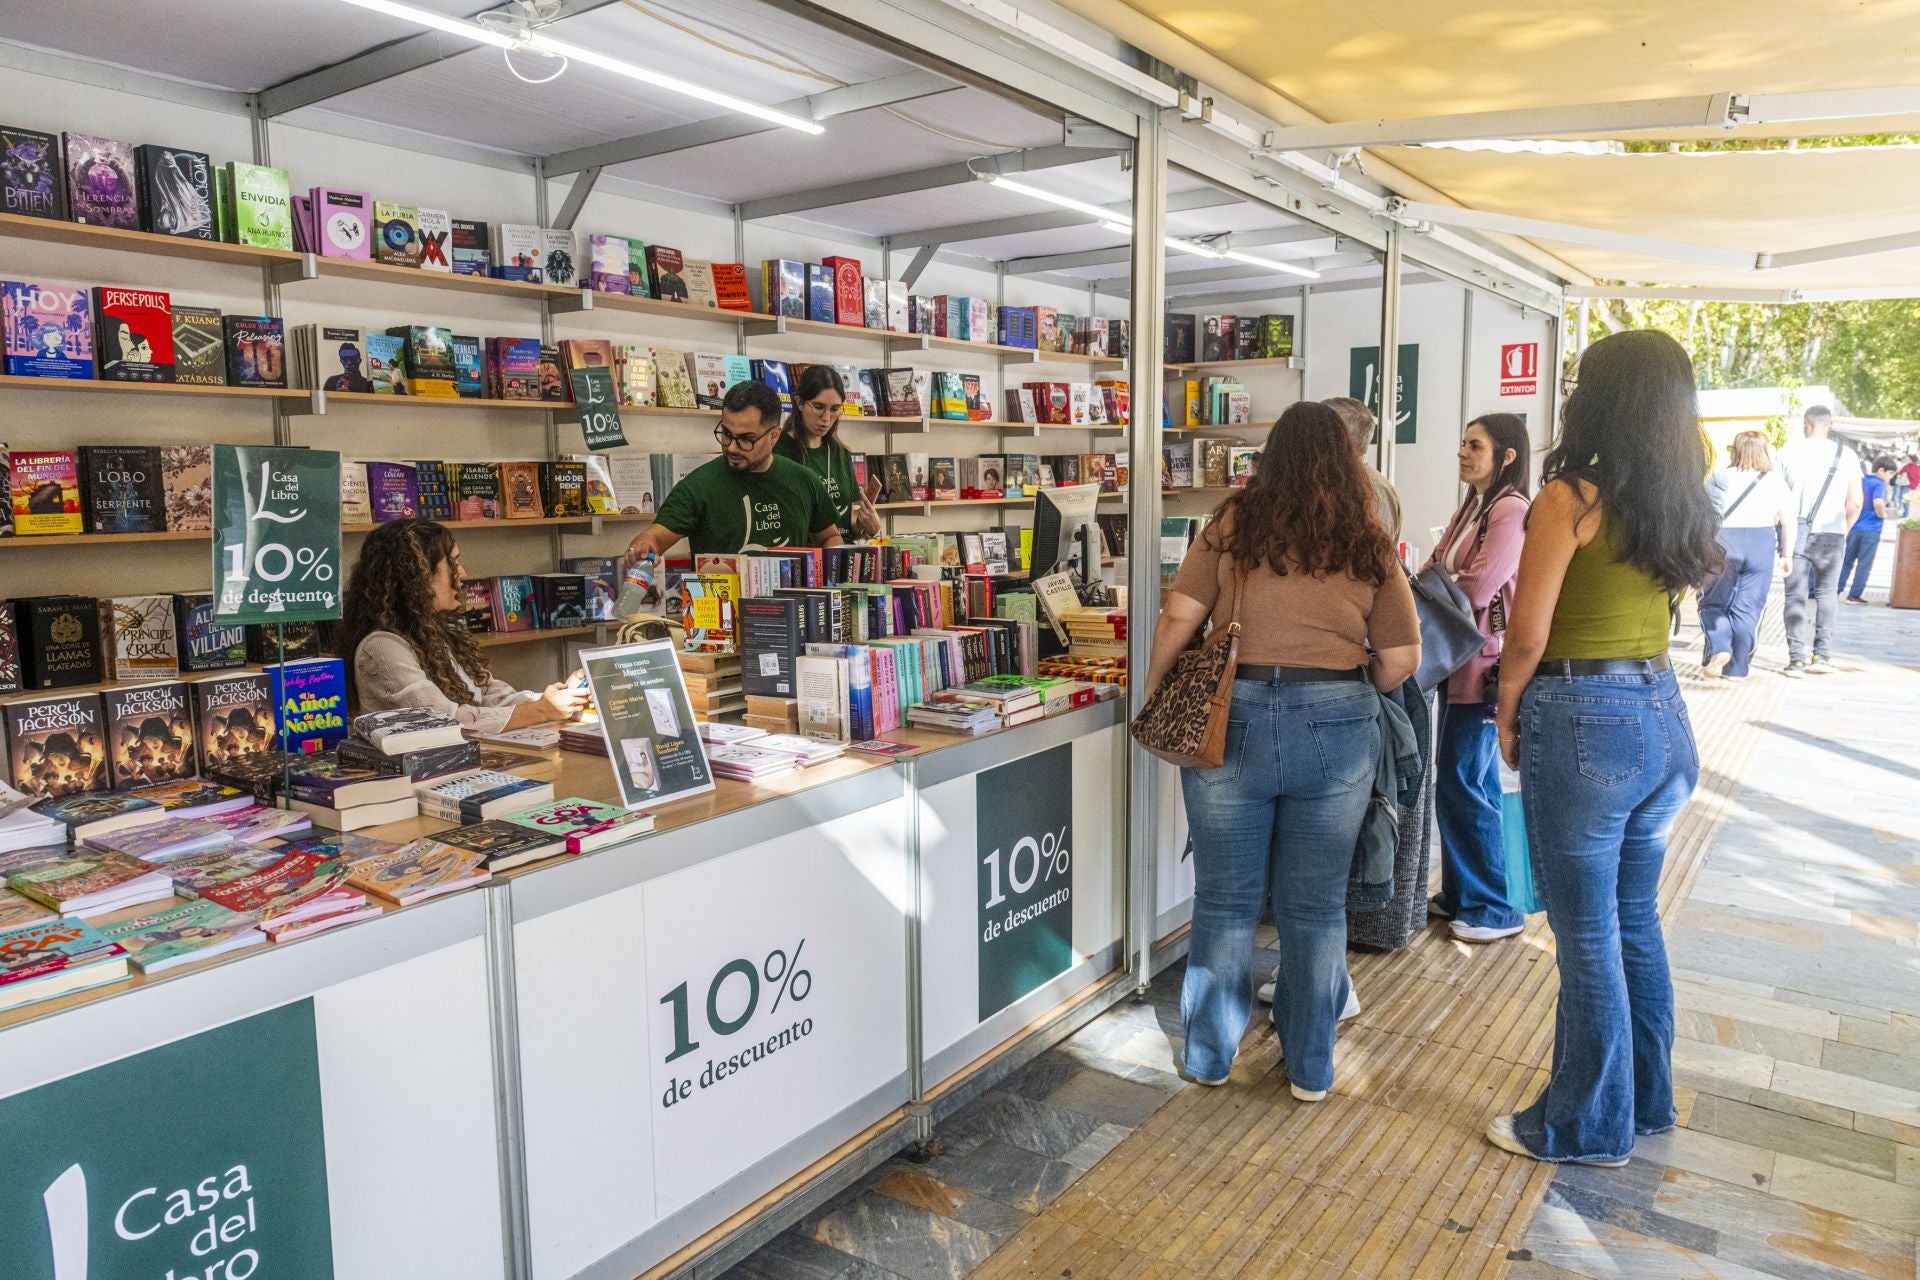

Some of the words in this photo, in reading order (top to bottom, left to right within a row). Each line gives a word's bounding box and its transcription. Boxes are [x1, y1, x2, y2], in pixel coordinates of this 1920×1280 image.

[5, 186, 54, 214] BITTEN
[75, 190, 133, 202] HERENCIA
[241, 191, 287, 207] ENVIDIA
[87, 203, 135, 215] SOMBRAS
[392, 211, 414, 220] FURIA
[247, 227, 262, 236] ANA
[262, 228, 286, 239] HUANG
[16, 287, 78, 313] HOY
[104, 290, 169, 312] PERSÉPOLIS
[184, 315, 221, 326] KUANG
[233, 329, 284, 346] Releasing
[176, 373, 224, 385] ATÁBASIS
[964, 380, 980, 394] 1973
[1501, 384, 1536, 395] EXTINTOR
[582, 412, 619, 434] 10%
[587, 435, 596, 444] de
[15, 458, 27, 466] LA
[28, 455, 71, 465] LIBRERÍA
[17, 464, 34, 473] DEL
[36, 464, 52, 472] FIN
[54, 463, 71, 471] DEL
[27, 472, 62, 481] MUNDO
[98, 471, 146, 484] LOBO
[272, 471, 299, 483] Casa
[555, 474, 572, 482] HIJO
[572, 474, 585, 482] DEL
[284, 482, 299, 492] del
[343, 480, 366, 488] CIENTE
[559, 482, 581, 490] REICH
[271, 489, 299, 501] Libro
[96, 498, 152, 510] SERPIENTE
[754, 502, 779, 513] Casa
[766, 511, 781, 521] del
[756, 521, 781, 531] Libro
[223, 543, 333, 582] 10%
[502, 579, 511, 588] EL
[1047, 578, 1066, 588] JAVIER
[223, 589, 244, 604] de
[248, 587, 333, 604] descuento
[503, 585, 520, 594] DES
[1046, 584, 1072, 596] CASTILLO
[503, 591, 521, 601] CON
[506, 598, 521, 606] TEN
[38, 606, 63, 614] SARAH
[509, 603, 521, 612] TO
[195, 608, 214, 625] ALI
[122, 626, 174, 641] PRÍNCIPE
[190, 626, 243, 657] VILLANO
[46, 647, 92, 663] LLAMAS
[125, 643, 172, 657] CRUEL
[47, 661, 92, 673] PLATEADAS
[614, 661, 633, 670] Firmas
[622, 668, 648, 678] Murcia
[214, 679, 256, 696] PERCY
[611, 682, 633, 691] Domingo
[125, 687, 171, 704] PERCY
[206, 687, 268, 711] JACKSON
[28, 700, 81, 720] PERCY
[116, 696, 184, 721] JACKSON
[280, 695, 341, 716] Amor
[303, 712, 314, 721] de
[17, 709, 95, 737] JACKSON
[536, 804, 604, 826] GOA
[983, 825, 1070, 909] 10%
[983, 920, 1001, 943] de
[1003, 887, 1070, 933] descuento
[660, 937, 812, 1064] 10%
[662, 1077, 692, 1109] de
[699, 1017, 813, 1090] descuento
[114, 1163, 253, 1241] Casa
[190, 1196, 257, 1256] del
